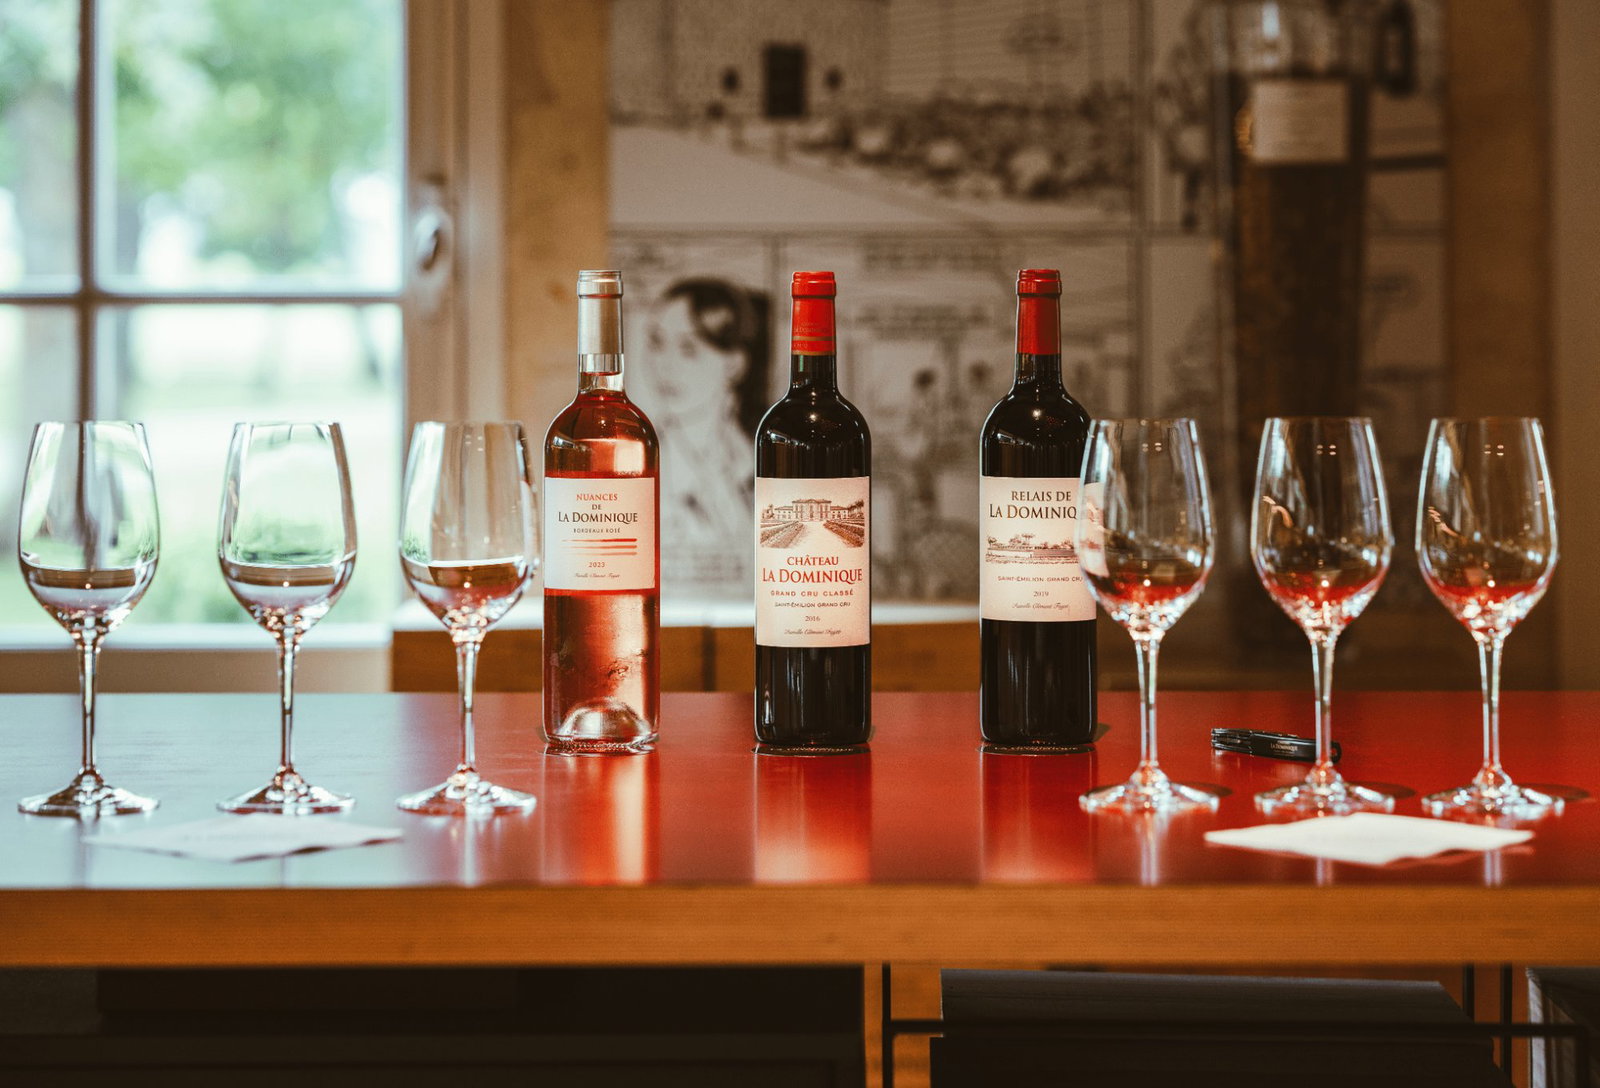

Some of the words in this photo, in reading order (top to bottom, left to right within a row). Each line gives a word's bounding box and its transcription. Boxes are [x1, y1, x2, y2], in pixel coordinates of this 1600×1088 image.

[576, 493, 618, 501] NUANCES
[1011, 490, 1052, 501] RELAIS
[1056, 491, 1072, 501] DE
[989, 503, 1003, 518] LA
[1007, 504, 1078, 519] DOMINIQ
[558, 511, 570, 522] LA
[572, 511, 638, 525] DOMINIQUE
[787, 554, 839, 566] CHÂTEAU
[762, 567, 776, 582] LA
[779, 568, 863, 585] DOMINIQUE
[770, 589, 797, 597] GRAND
[823, 588, 854, 597] CLASSÉ
